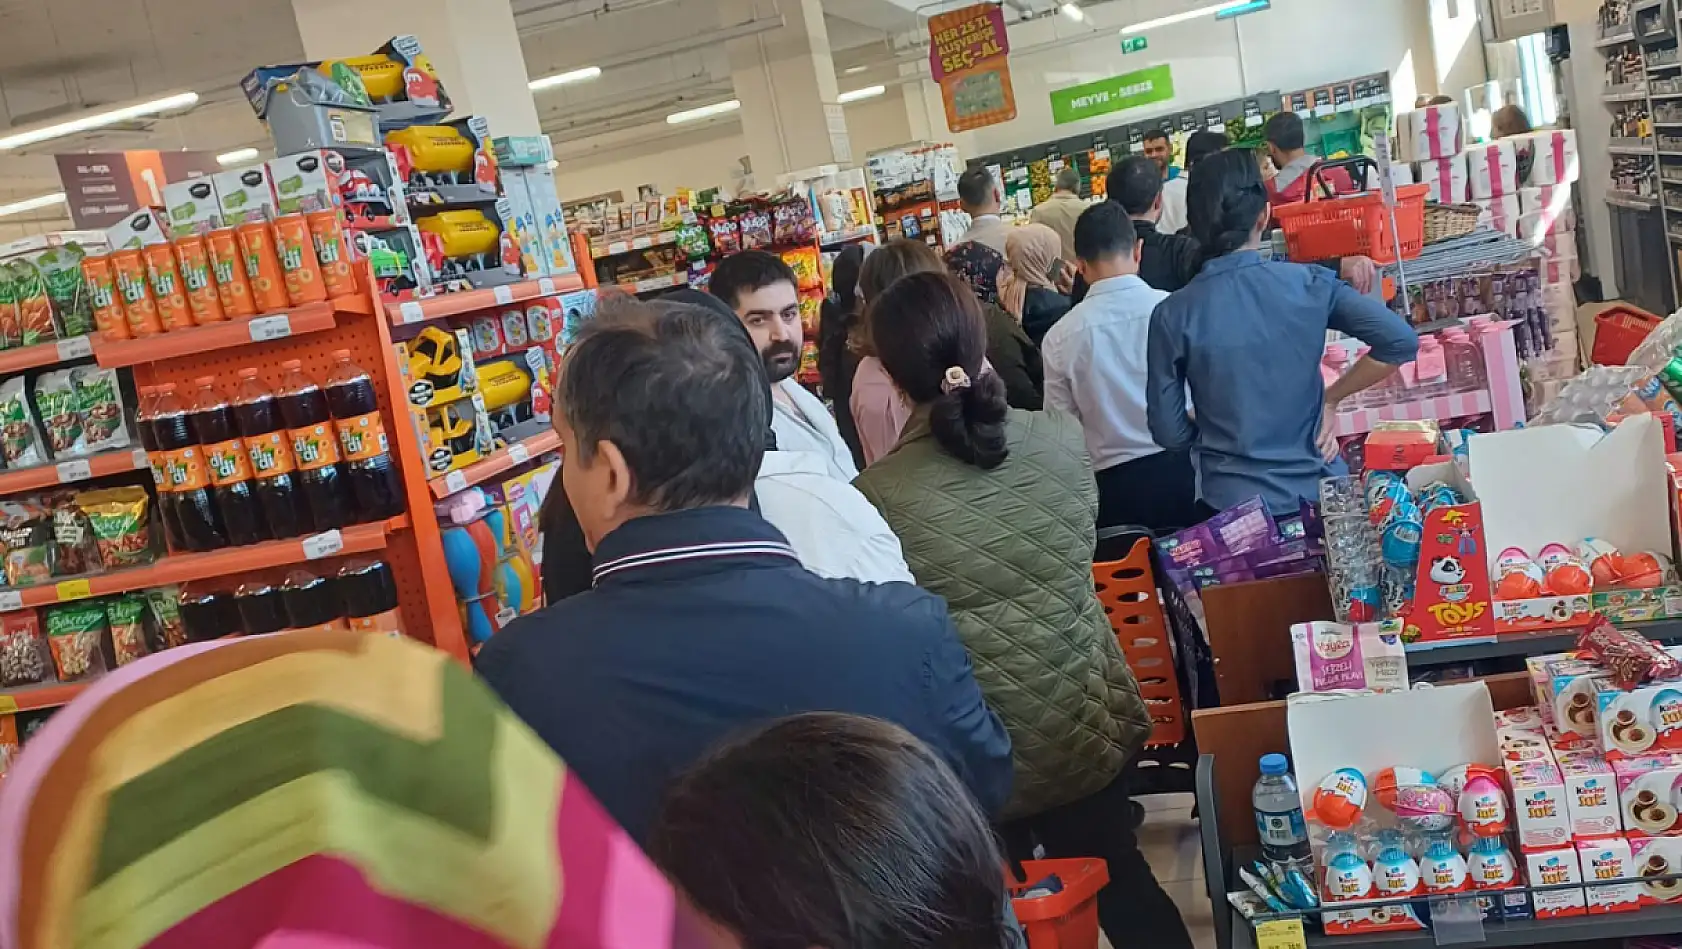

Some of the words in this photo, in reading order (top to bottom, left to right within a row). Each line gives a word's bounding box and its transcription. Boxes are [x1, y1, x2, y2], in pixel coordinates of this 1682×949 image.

[934, 28, 959, 45] HER
[960, 21, 975, 35] 25
[975, 15, 992, 28] TL
[1071, 91, 1108, 109] MEYVE
[140, 168, 161, 206] 1
[1428, 601, 1488, 625] TOYS
